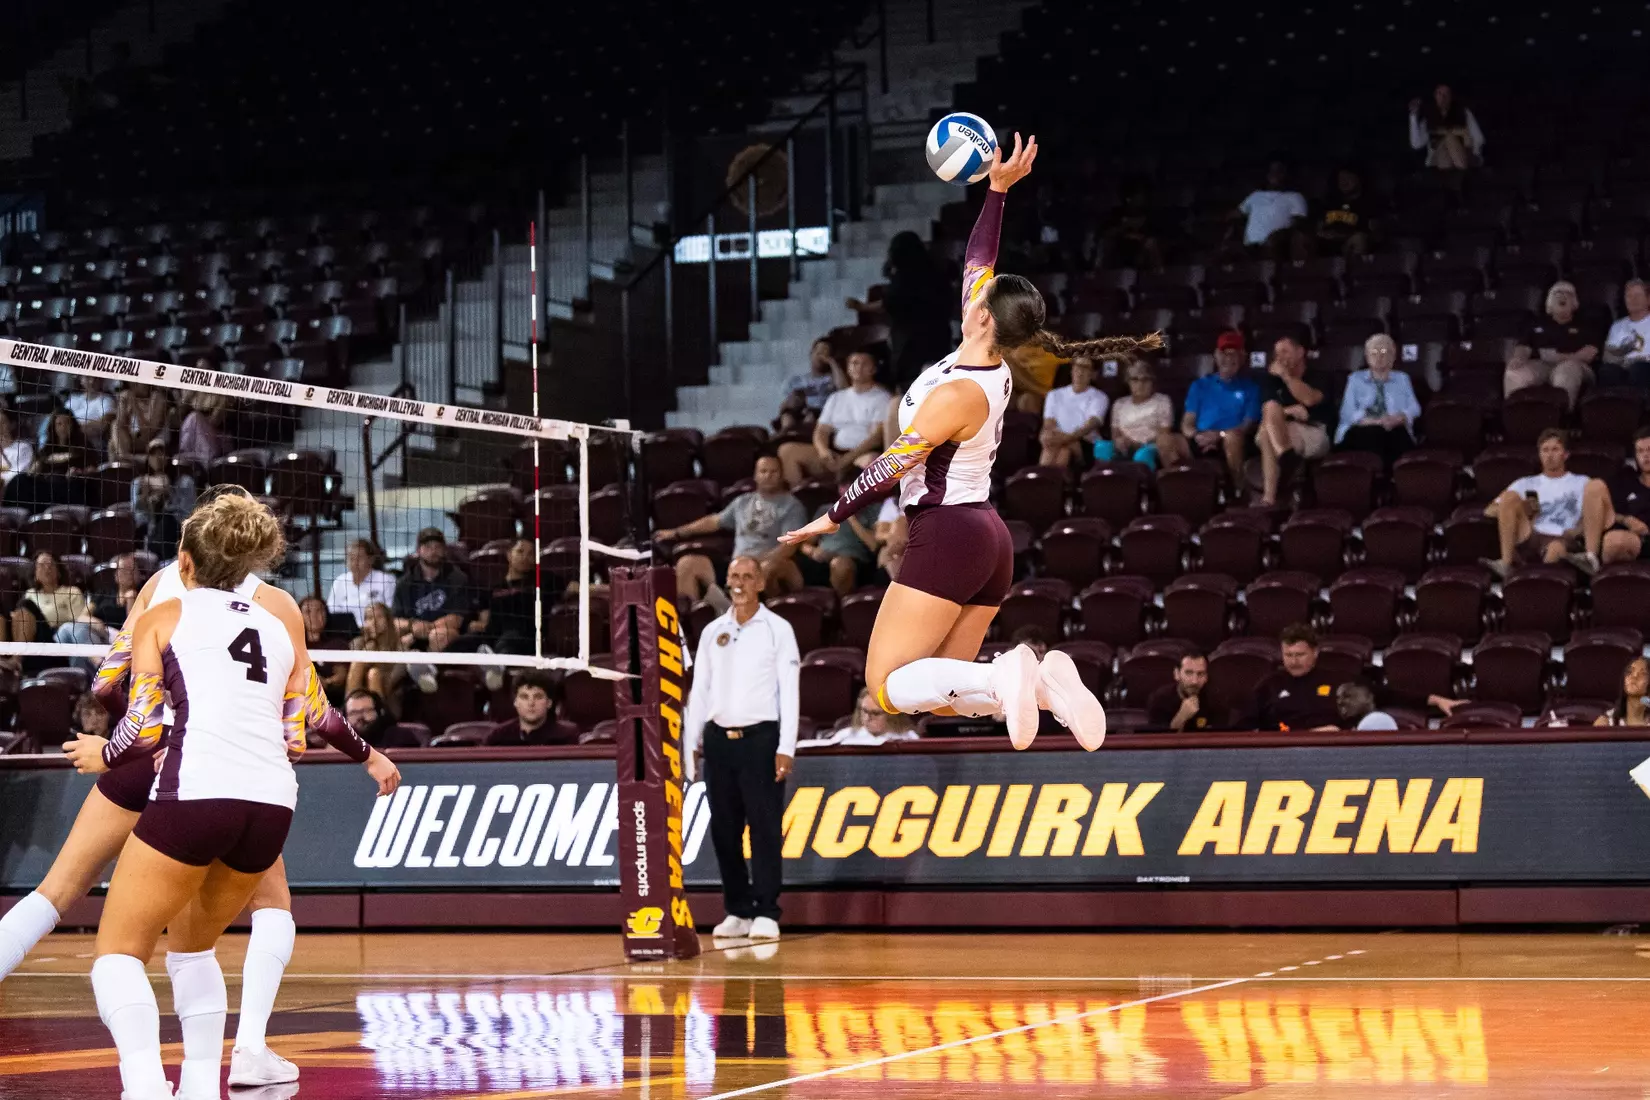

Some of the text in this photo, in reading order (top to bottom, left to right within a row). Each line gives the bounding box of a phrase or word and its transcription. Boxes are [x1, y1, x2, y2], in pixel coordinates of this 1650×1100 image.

[958, 125, 990, 154] molten
[10, 343, 141, 377] CENTRAL MICHIGAN VOLLEYBALL
[180, 368, 292, 398] CENTRAL MICHIGAN VOLLEYBALL
[326, 389, 425, 417] CENTRAL MICHIGAN VOLLEYBALL
[455, 408, 480, 423] CENTRAL
[481, 412, 509, 427] MICHIGAN
[227, 627, 267, 684] 4
[655, 596, 694, 929] CHIPPEWAS
[1177, 777, 1484, 856] ARENA
[632, 800, 650, 897] sports imports
[626, 906, 664, 939] C
